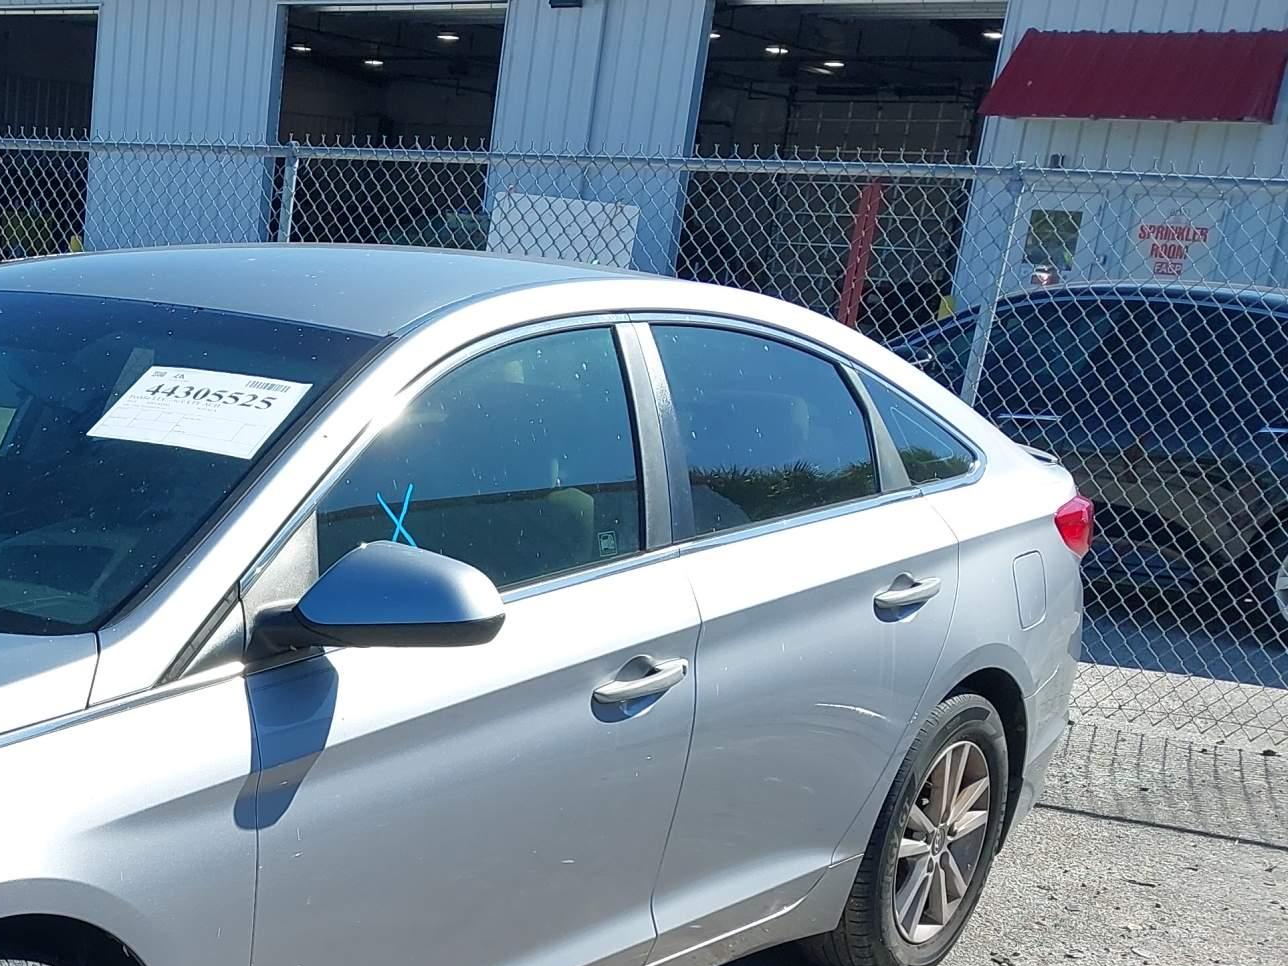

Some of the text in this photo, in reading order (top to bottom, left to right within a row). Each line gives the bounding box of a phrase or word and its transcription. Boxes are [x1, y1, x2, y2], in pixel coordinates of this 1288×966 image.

[1137, 224, 1209, 243] SPRINKLER
[1150, 243, 1189, 260] ROOM
[145, 383, 278, 410] 44305525
